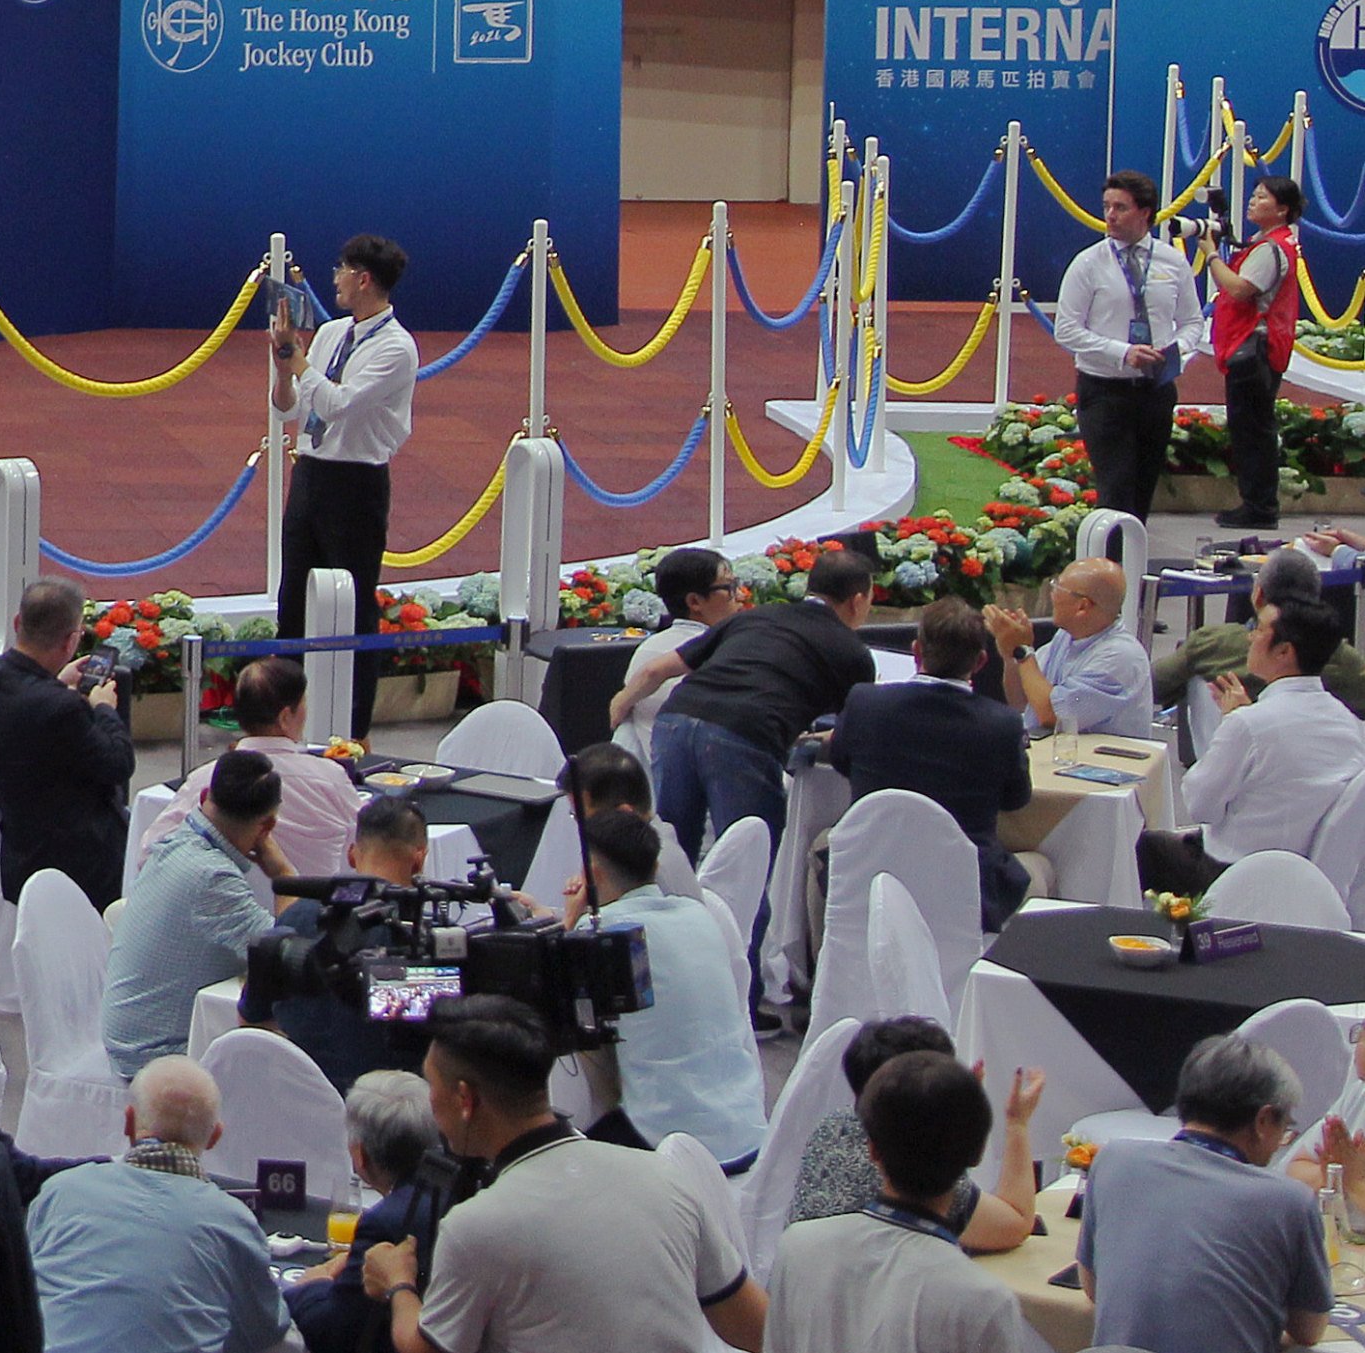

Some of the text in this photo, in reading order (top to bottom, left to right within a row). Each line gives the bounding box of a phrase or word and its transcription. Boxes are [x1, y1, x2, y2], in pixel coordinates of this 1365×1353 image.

[241, 7, 410, 39] The Hong Kong
[1318, 6, 1341, 39] HONG
[239, 42, 374, 73] Jockey Club
[875, 69, 1095, 89] 香港國際馬匹拍賣會
[268, 1172, 296, 1194] 66
